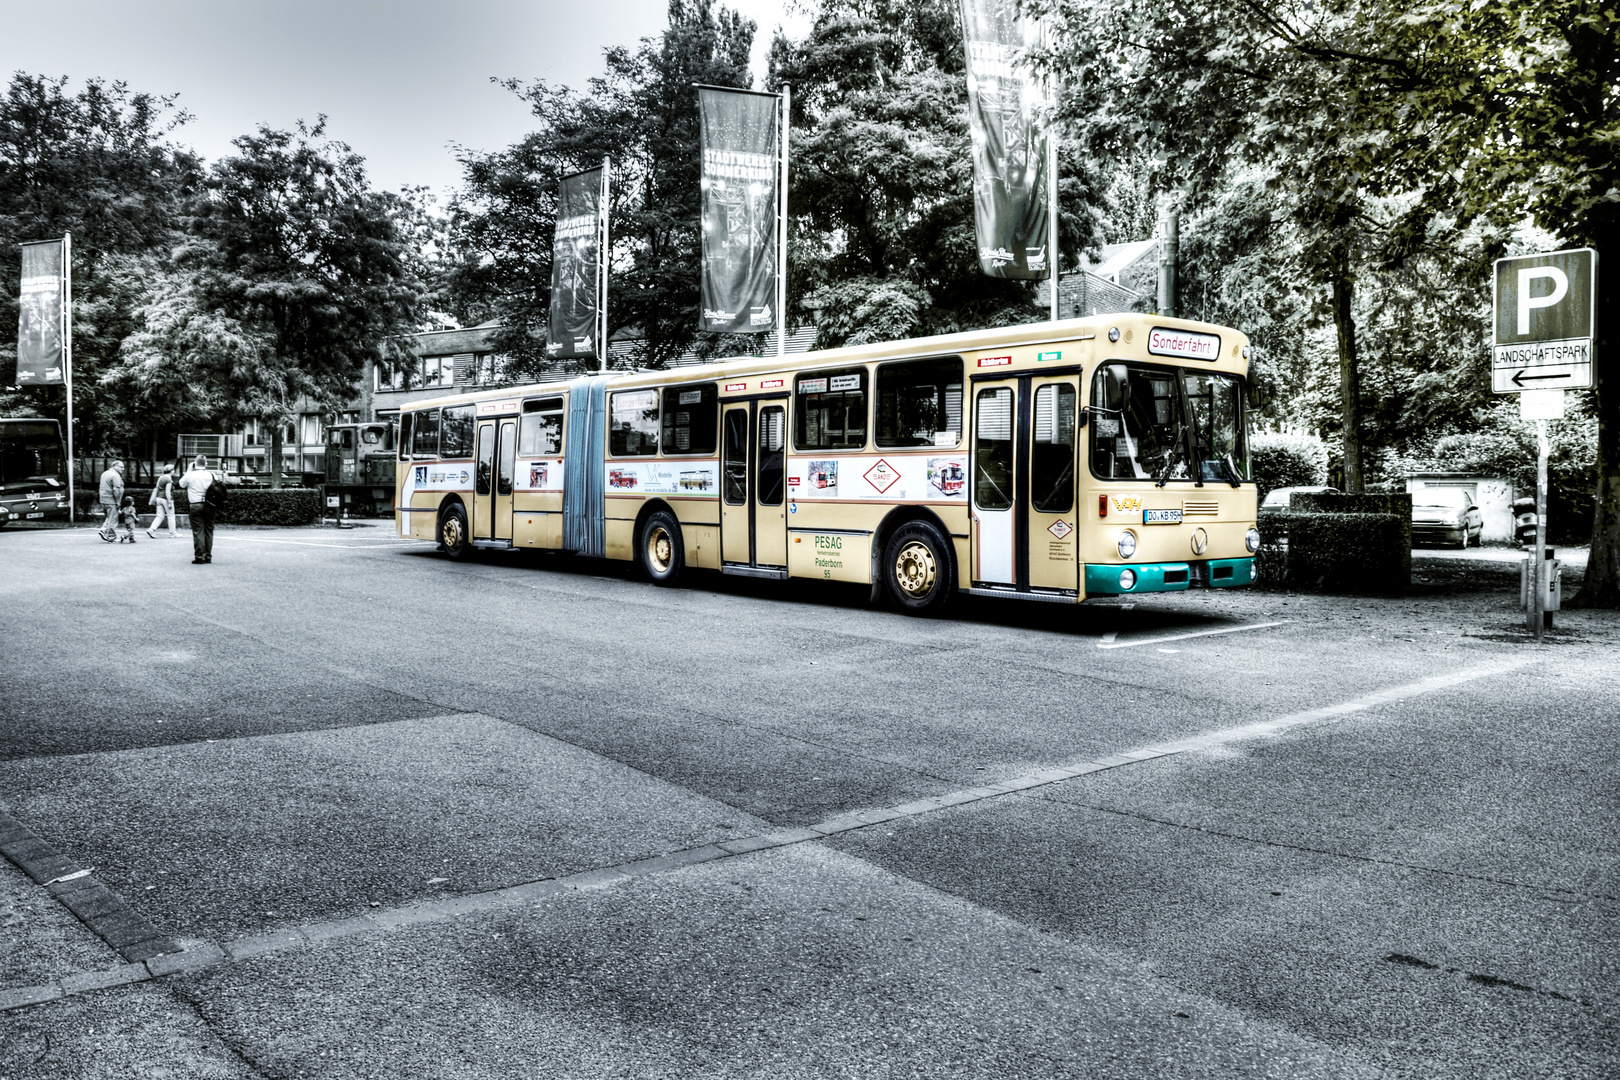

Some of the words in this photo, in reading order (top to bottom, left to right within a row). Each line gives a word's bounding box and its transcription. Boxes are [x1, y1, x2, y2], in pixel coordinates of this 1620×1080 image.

[704, 149, 772, 167] STADTWERKE
[704, 162, 773, 180] SOMMERKINO
[554, 225, 596, 240] OMMERKINO
[1518, 266, 1569, 335] P
[1152, 333, 1211, 353] Sonderfahrt
[1495, 345, 1588, 363] LANDSCHAFTSPARK
[1160, 511, 1169, 521] KB
[815, 536, 842, 549] PESAG
[815, 557, 843, 568] Paderborn
[824, 569, 831, 579] 95
